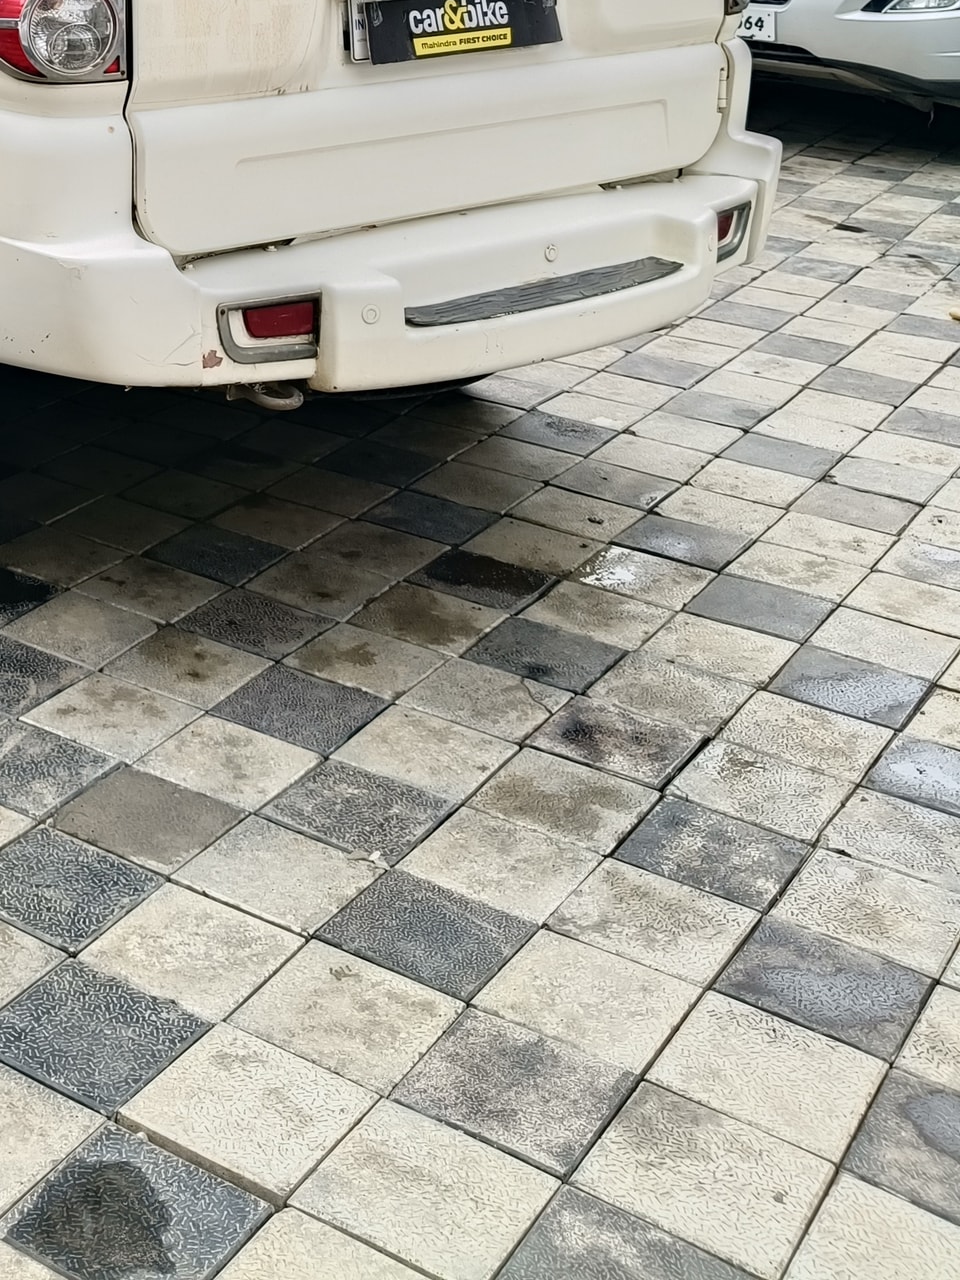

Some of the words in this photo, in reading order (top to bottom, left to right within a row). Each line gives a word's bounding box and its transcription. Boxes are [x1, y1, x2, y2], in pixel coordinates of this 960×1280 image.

[421, 40, 457, 50] Mahindra
[459, 36, 480, 46] FIRST
[481, 33, 508, 43] CHOICE
